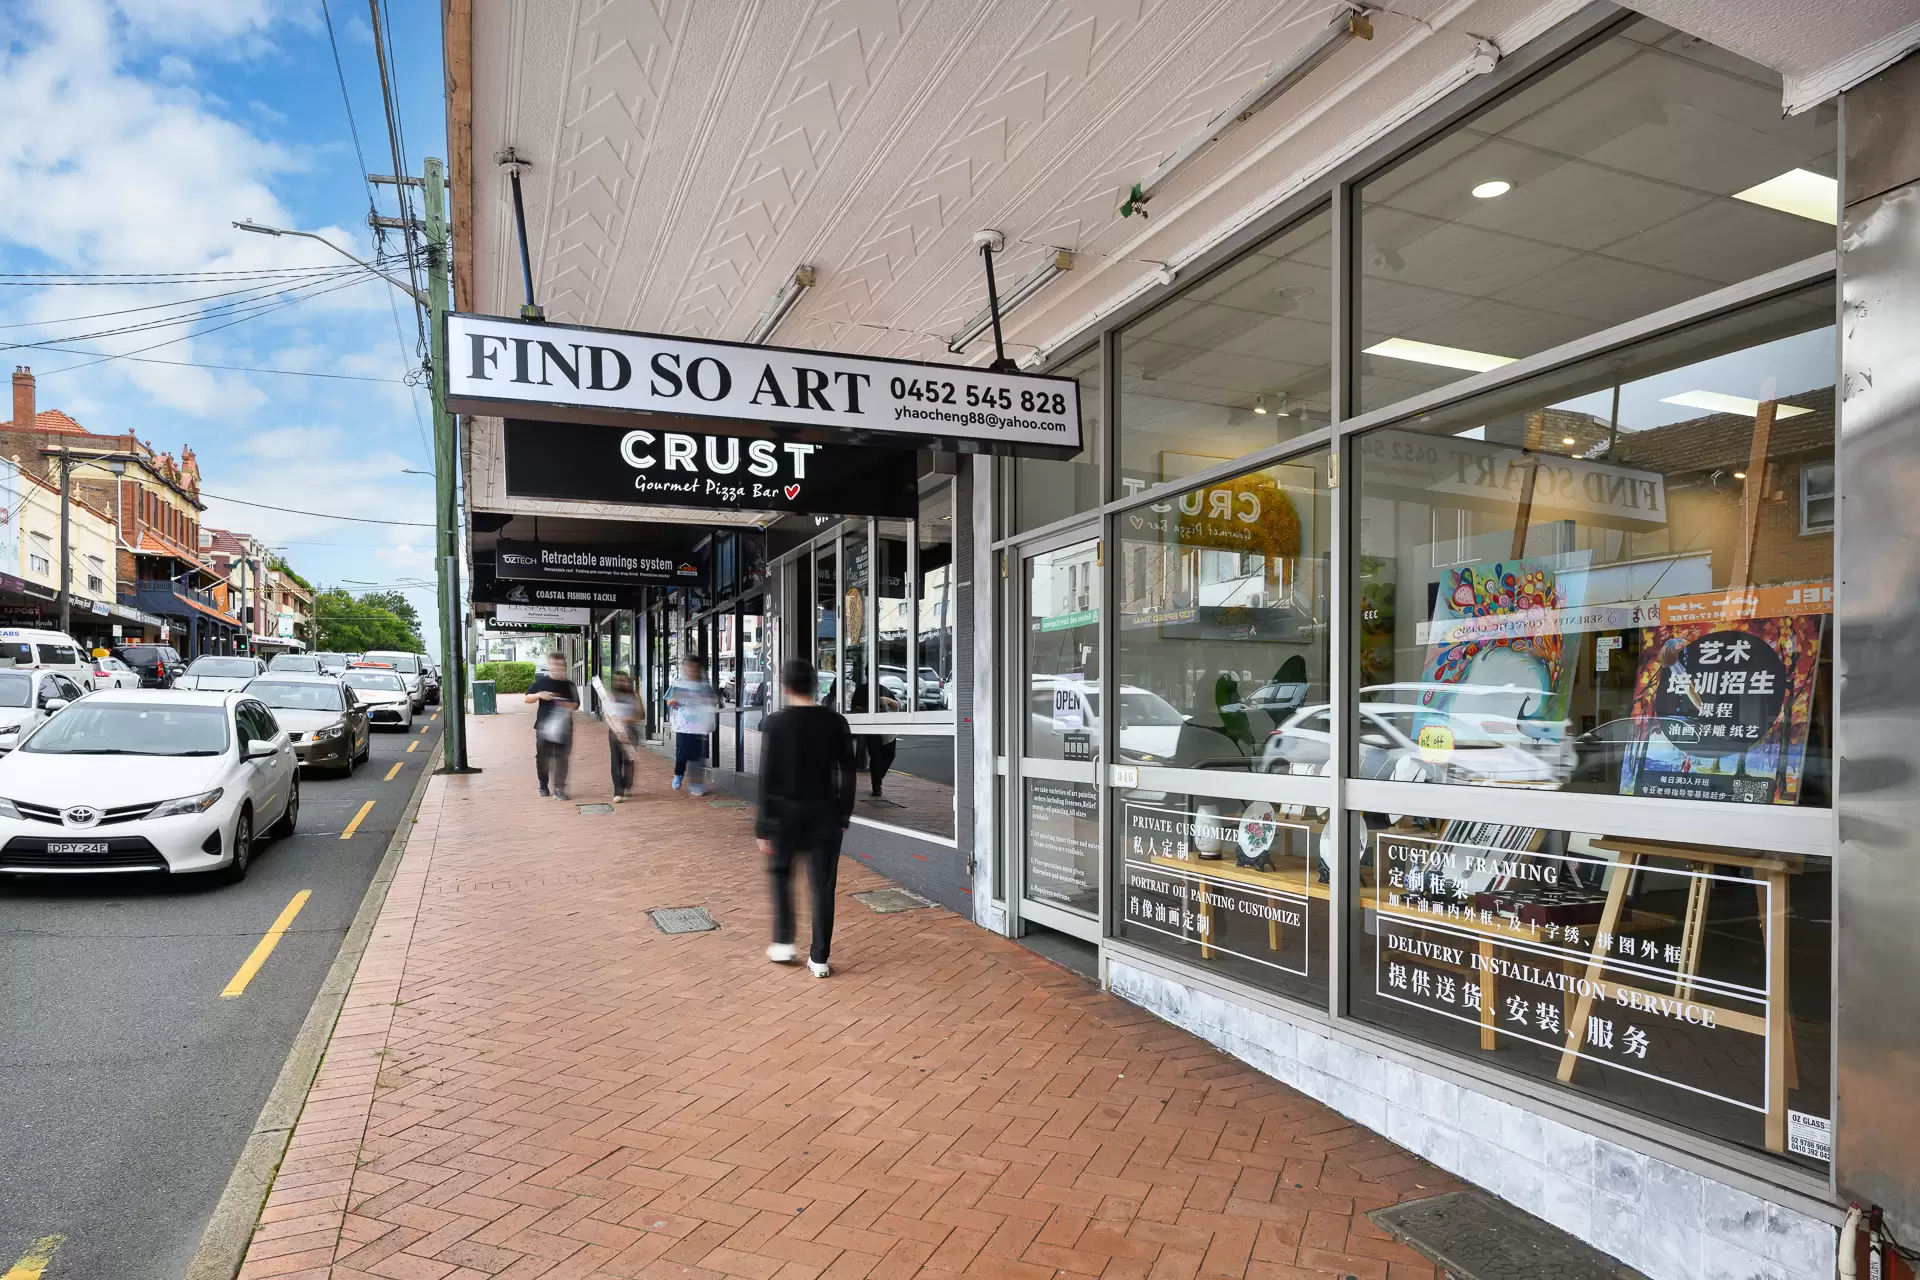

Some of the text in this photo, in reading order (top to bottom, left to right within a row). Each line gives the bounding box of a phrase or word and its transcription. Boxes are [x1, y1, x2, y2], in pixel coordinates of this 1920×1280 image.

[466, 333, 870, 414] FIND SO ART
[890, 377, 1067, 416] 0452 545 828
[894, 405, 1067, 432] yhaocheng88@yahoo.com
[620, 430, 815, 479] CRUST
[635, 475, 779, 501] Gourmet Pizza Bar
[503, 555, 537, 565] OZTECH
[541, 549, 596, 565] Retractable
[599, 556, 637, 570] awnings
[640, 558, 673, 571] system
[536, 591, 616, 602] COASTAL FISHING TACKLE
[1698, 640, 1752, 665] 艺术
[1666, 670, 1776, 695] 培训招生
[1056, 690, 1080, 710] OPEN
[1698, 702, 1733, 718] 课程
[1668, 723, 1760, 739] 油画 浮雕 纸艺
[1046, 796, 1064, 805] including
[1078, 792, 1096, 800] painting
[1133, 815, 1240, 843] PRIVATE CUSTOMIZE
[1133, 836, 1189, 862] 私人定制
[1388, 845, 1456, 869] CUSTOM
[1465, 855, 1558, 885] FRAMING
[1388, 868, 1469, 900] 定制框架
[1131, 875, 1301, 927] PORTRAIT OIL PAINTING CUSTOMIZE
[1130, 896, 1210, 936] 肖像油画定制
[1387, 934, 1715, 1030] DELIVERY INSTALLATION SERVICE
[1387, 961, 1650, 1059] 提供送货、安装、服务
[1792, 1114, 1825, 1130] OZ GLASS
[1791, 1136, 1798, 1144] 02
[1791, 1143, 1806, 1153] 0410
[1807, 1148, 1818, 1157] 392
